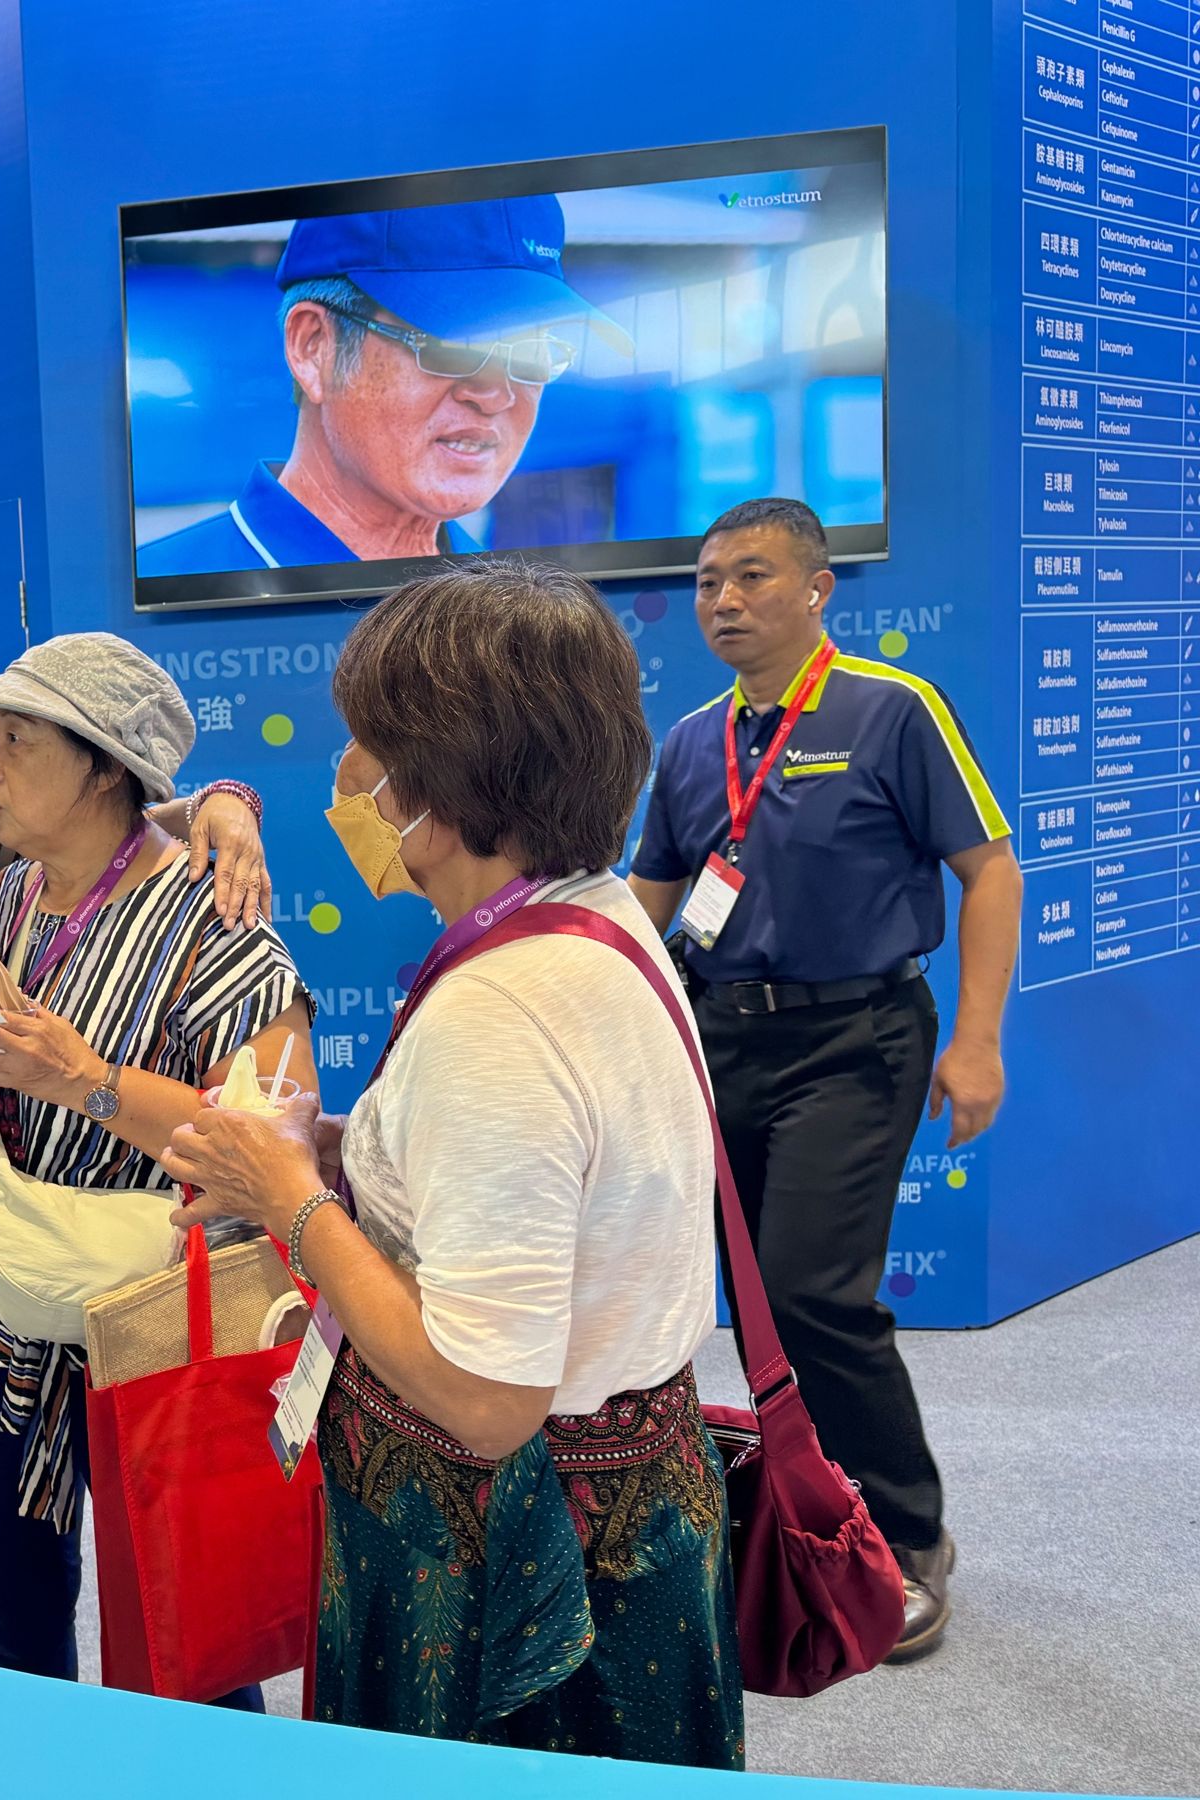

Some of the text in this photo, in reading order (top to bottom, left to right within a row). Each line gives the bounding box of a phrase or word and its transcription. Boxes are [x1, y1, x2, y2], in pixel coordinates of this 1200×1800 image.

[1102, 20, 1136, 42] Penicillin G
[1101, 59, 1136, 81] Cephalexin
[1038, 85, 1084, 110] Cephalosporins
[1101, 89, 1129, 109] Ceftiofur
[1101, 120, 1138, 142] Cefquinome
[1101, 159, 1136, 180] Gentamicin
[1035, 171, 1085, 195] Aminoglycosides
[1100, 189, 1134, 208] Kanamycin
[1040, 232, 1079, 258] 四環素類
[1100, 227, 1174, 254] Chlortetracycline calcium
[1041, 259, 1079, 279] Tetracyclines
[1100, 256, 1147, 277] Oxytetracycline
[1100, 287, 1136, 305] Doxycycline
[1040, 345, 1079, 362] Lincosamides
[1100, 339, 1134, 357] Lincomycin
[1099, 392, 1142, 408] Thiamphenicol
[1035, 413, 1084, 430] Aminoglycosides
[1099, 421, 1131, 435] Florfenicol
[1098, 459, 1119, 474] Tylosin
[1044, 472, 1072, 493] 巨環類
[1098, 488, 1128, 501] Tilmicosin
[1043, 500, 1074, 513] Macrolides
[1098, 517, 1127, 533] Tylvalosin
[1097, 569, 1123, 581] Tiamulin
[1037, 583, 1079, 596] Pleuromutilins
[822, 603, 953, 637] CLEAN®
[1096, 620, 1159, 633] Sulfamonomethoxine
[1096, 647, 1148, 661] Sulfamethoxazole
[1038, 675, 1077, 689] Sulfonamides
[1096, 676, 1147, 691] Sulfadimethoxine
[1096, 705, 1132, 720] Sulfadiazine
[1038, 742, 1077, 757] Trimethoprim
[1096, 734, 1141, 749] Sulfamethazine
[1096, 762, 1133, 778] Sulfathiazole
[1096, 798, 1130, 814] Flumequine
[1096, 825, 1131, 842] Enrofloxacin
[1040, 835, 1073, 850] Quinolones
[1096, 862, 1124, 878] Bacitracin
[1096, 890, 1118, 904] Colistin
[1043, 900, 1071, 924] 多肽類
[1096, 916, 1126, 933] Enramycin
[1038, 926, 1075, 944] Polypeptides
[1096, 943, 1131, 961] Nosiheptide
